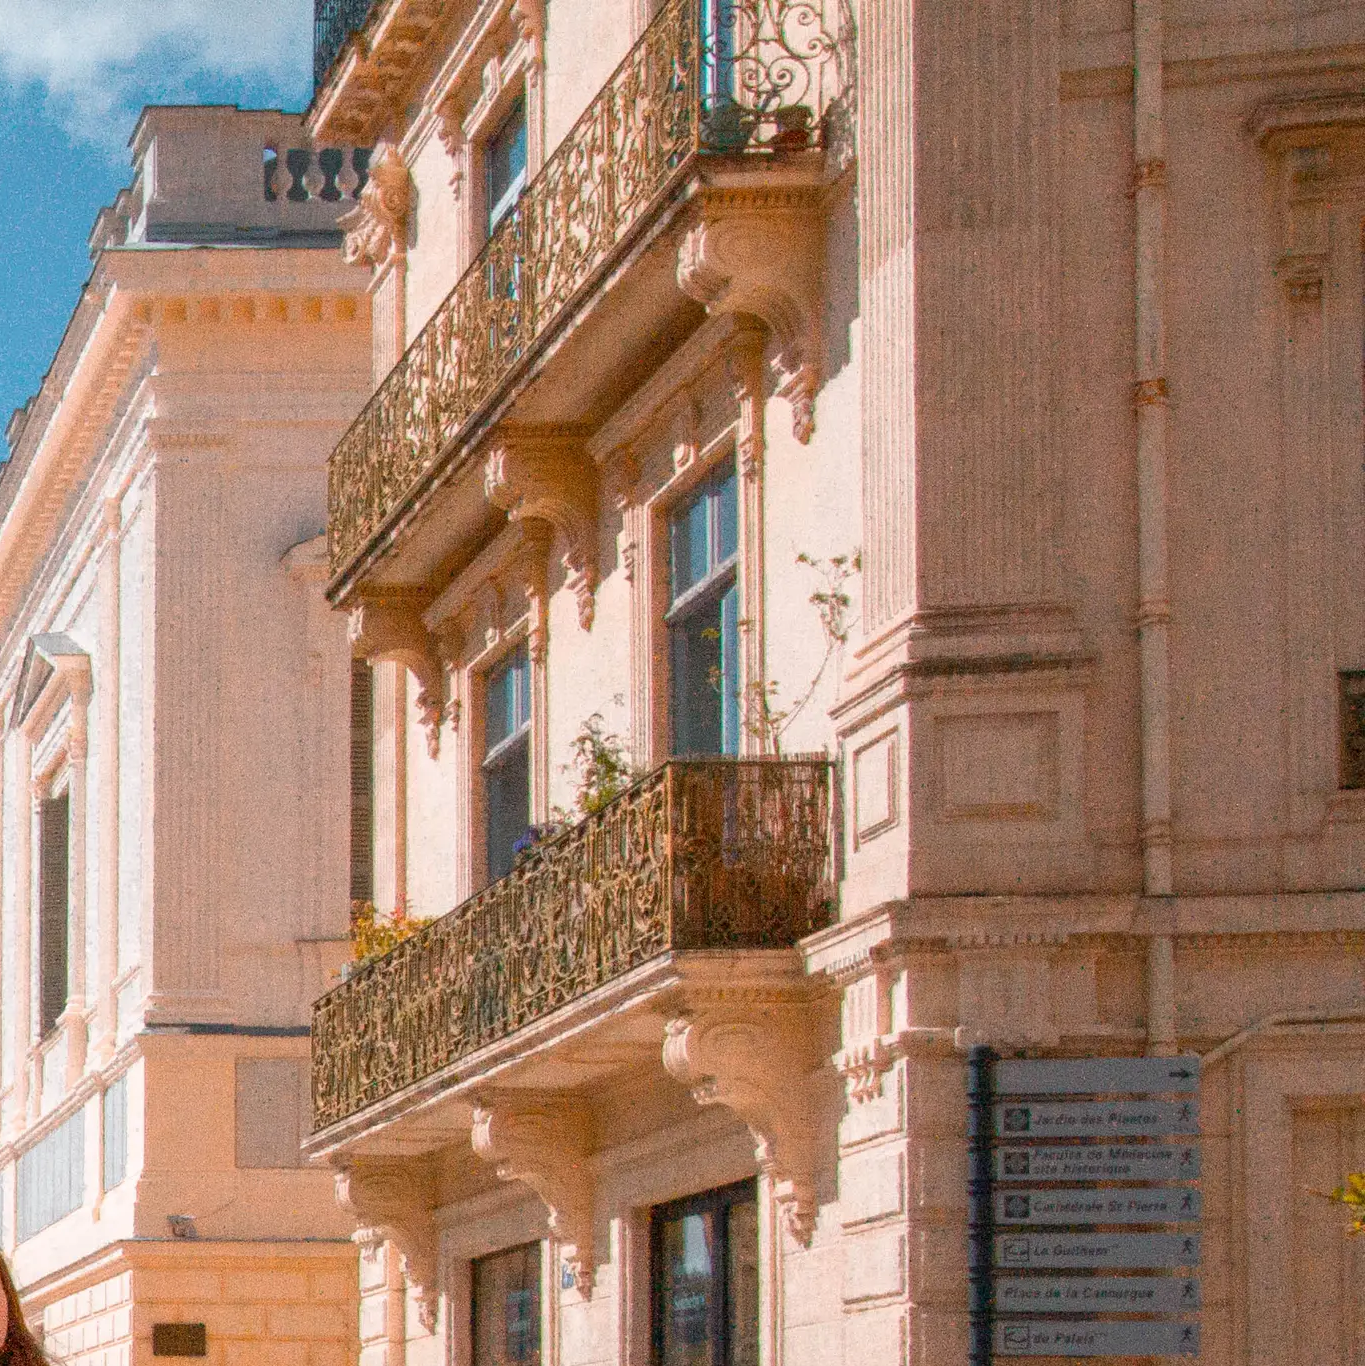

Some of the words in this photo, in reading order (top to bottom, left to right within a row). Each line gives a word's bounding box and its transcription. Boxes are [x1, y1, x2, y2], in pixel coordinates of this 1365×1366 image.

[1081, 1112, 1103, 1125] des
[1108, 1112, 1157, 1125] Plantes
[1004, 1286, 1042, 1299] Place
